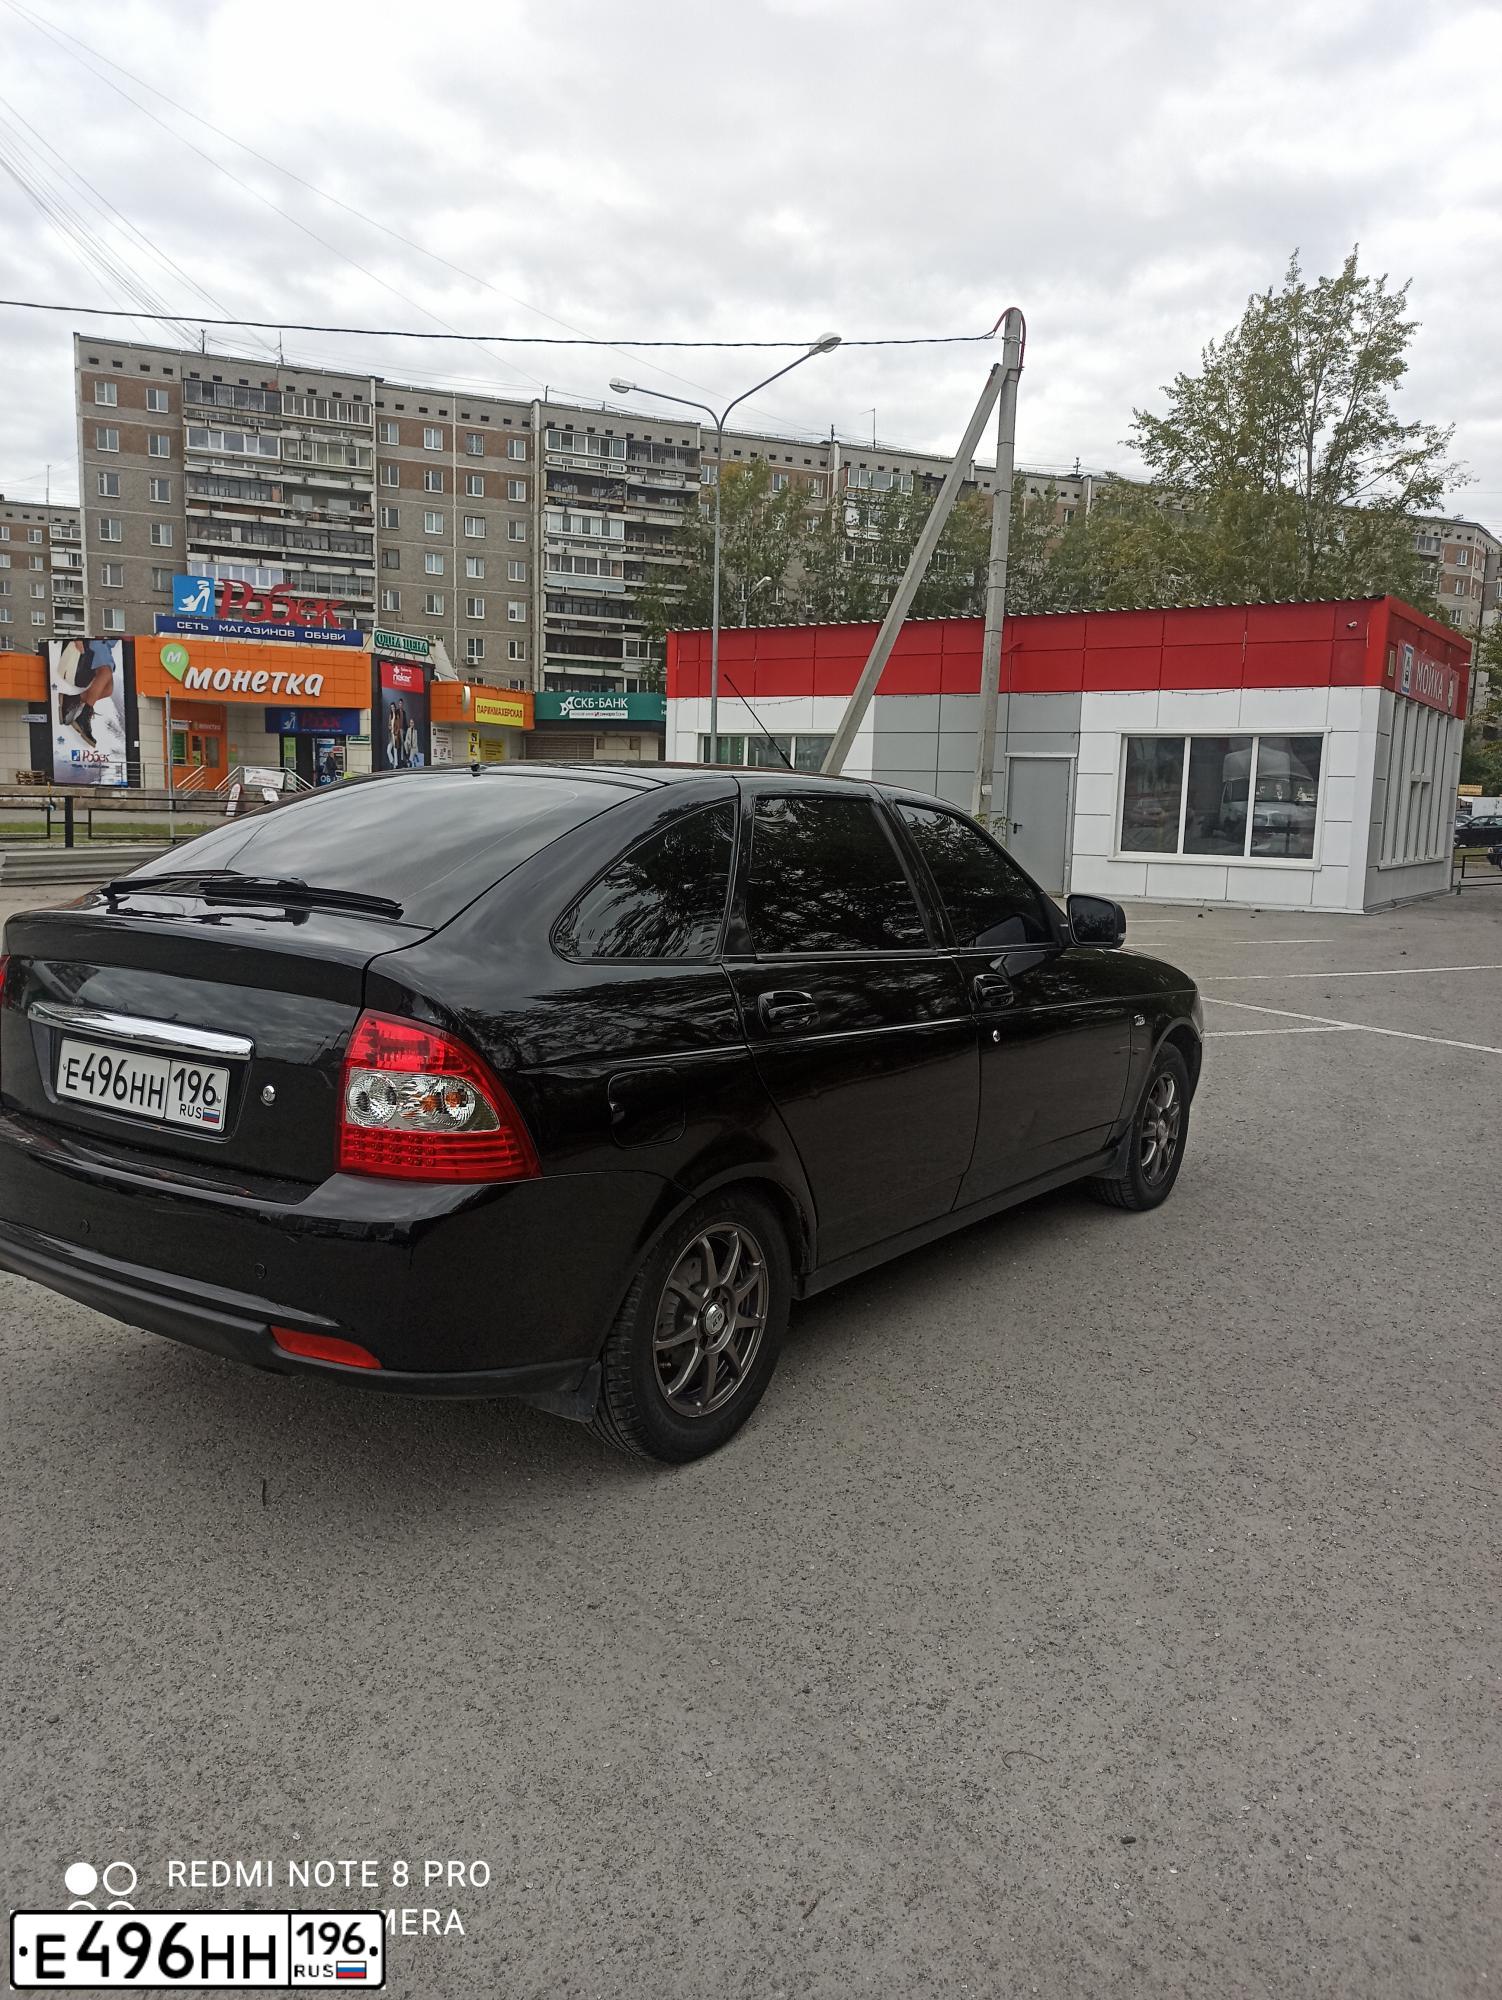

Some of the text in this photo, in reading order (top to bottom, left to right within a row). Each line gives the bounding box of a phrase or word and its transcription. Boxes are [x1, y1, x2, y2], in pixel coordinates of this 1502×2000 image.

[218, 578, 345, 628] Робек
[176, 621, 346, 641] СЕТЬ МАГАЗИНОВ ОБУВИ
[377, 633, 427, 653] ОДНА ЦЕНА
[1415, 660, 1443, 702] МОЙКА
[476, 704, 523, 719] ПАРИКМАХЕРСКАЯ
[573, 697, 628, 709] СКБ-БАНК
[173, 1067, 218, 1106] 196
[179, 1103, 202, 1119] RUS
